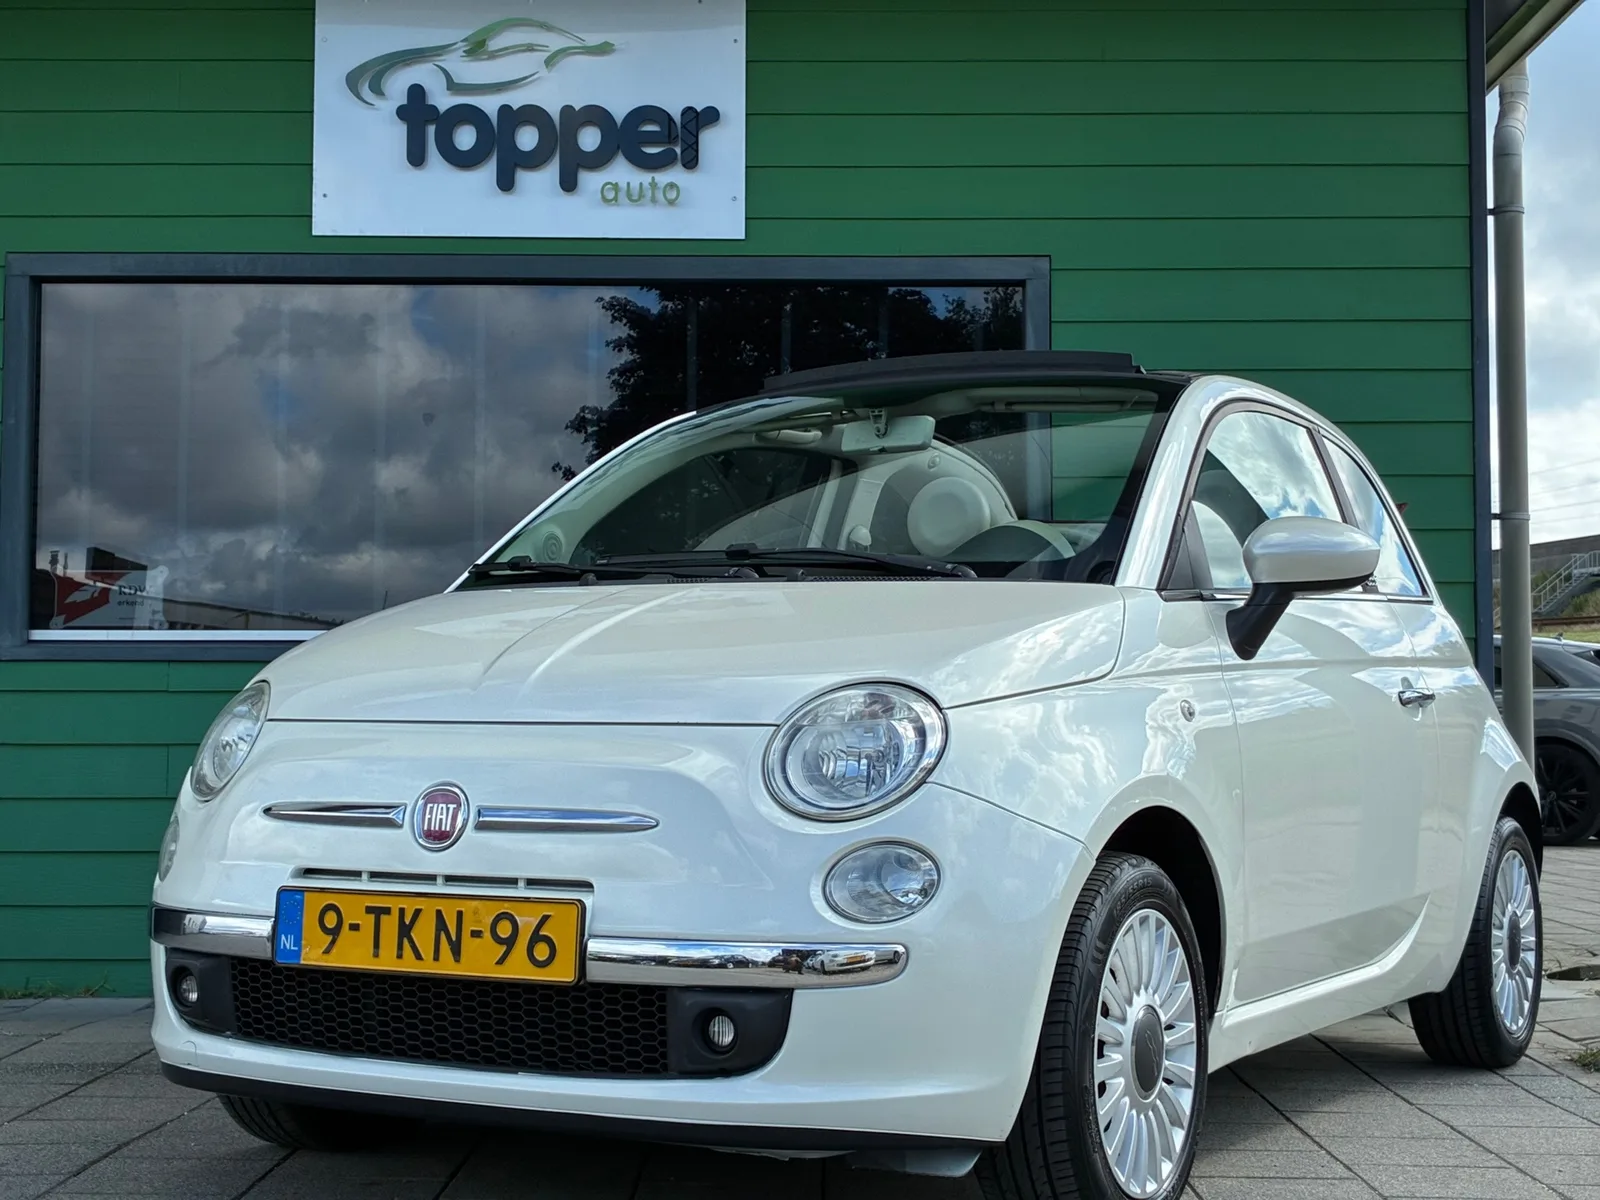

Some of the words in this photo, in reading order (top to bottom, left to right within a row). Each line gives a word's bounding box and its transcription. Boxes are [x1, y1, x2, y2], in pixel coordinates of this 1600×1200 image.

[396, 83, 720, 193] topper
[600, 176, 681, 205] auto
[424, 803, 457, 831] FIAT
[280, 933, 298, 950] NL
[318, 901, 557, 968] 9-TKN-96
